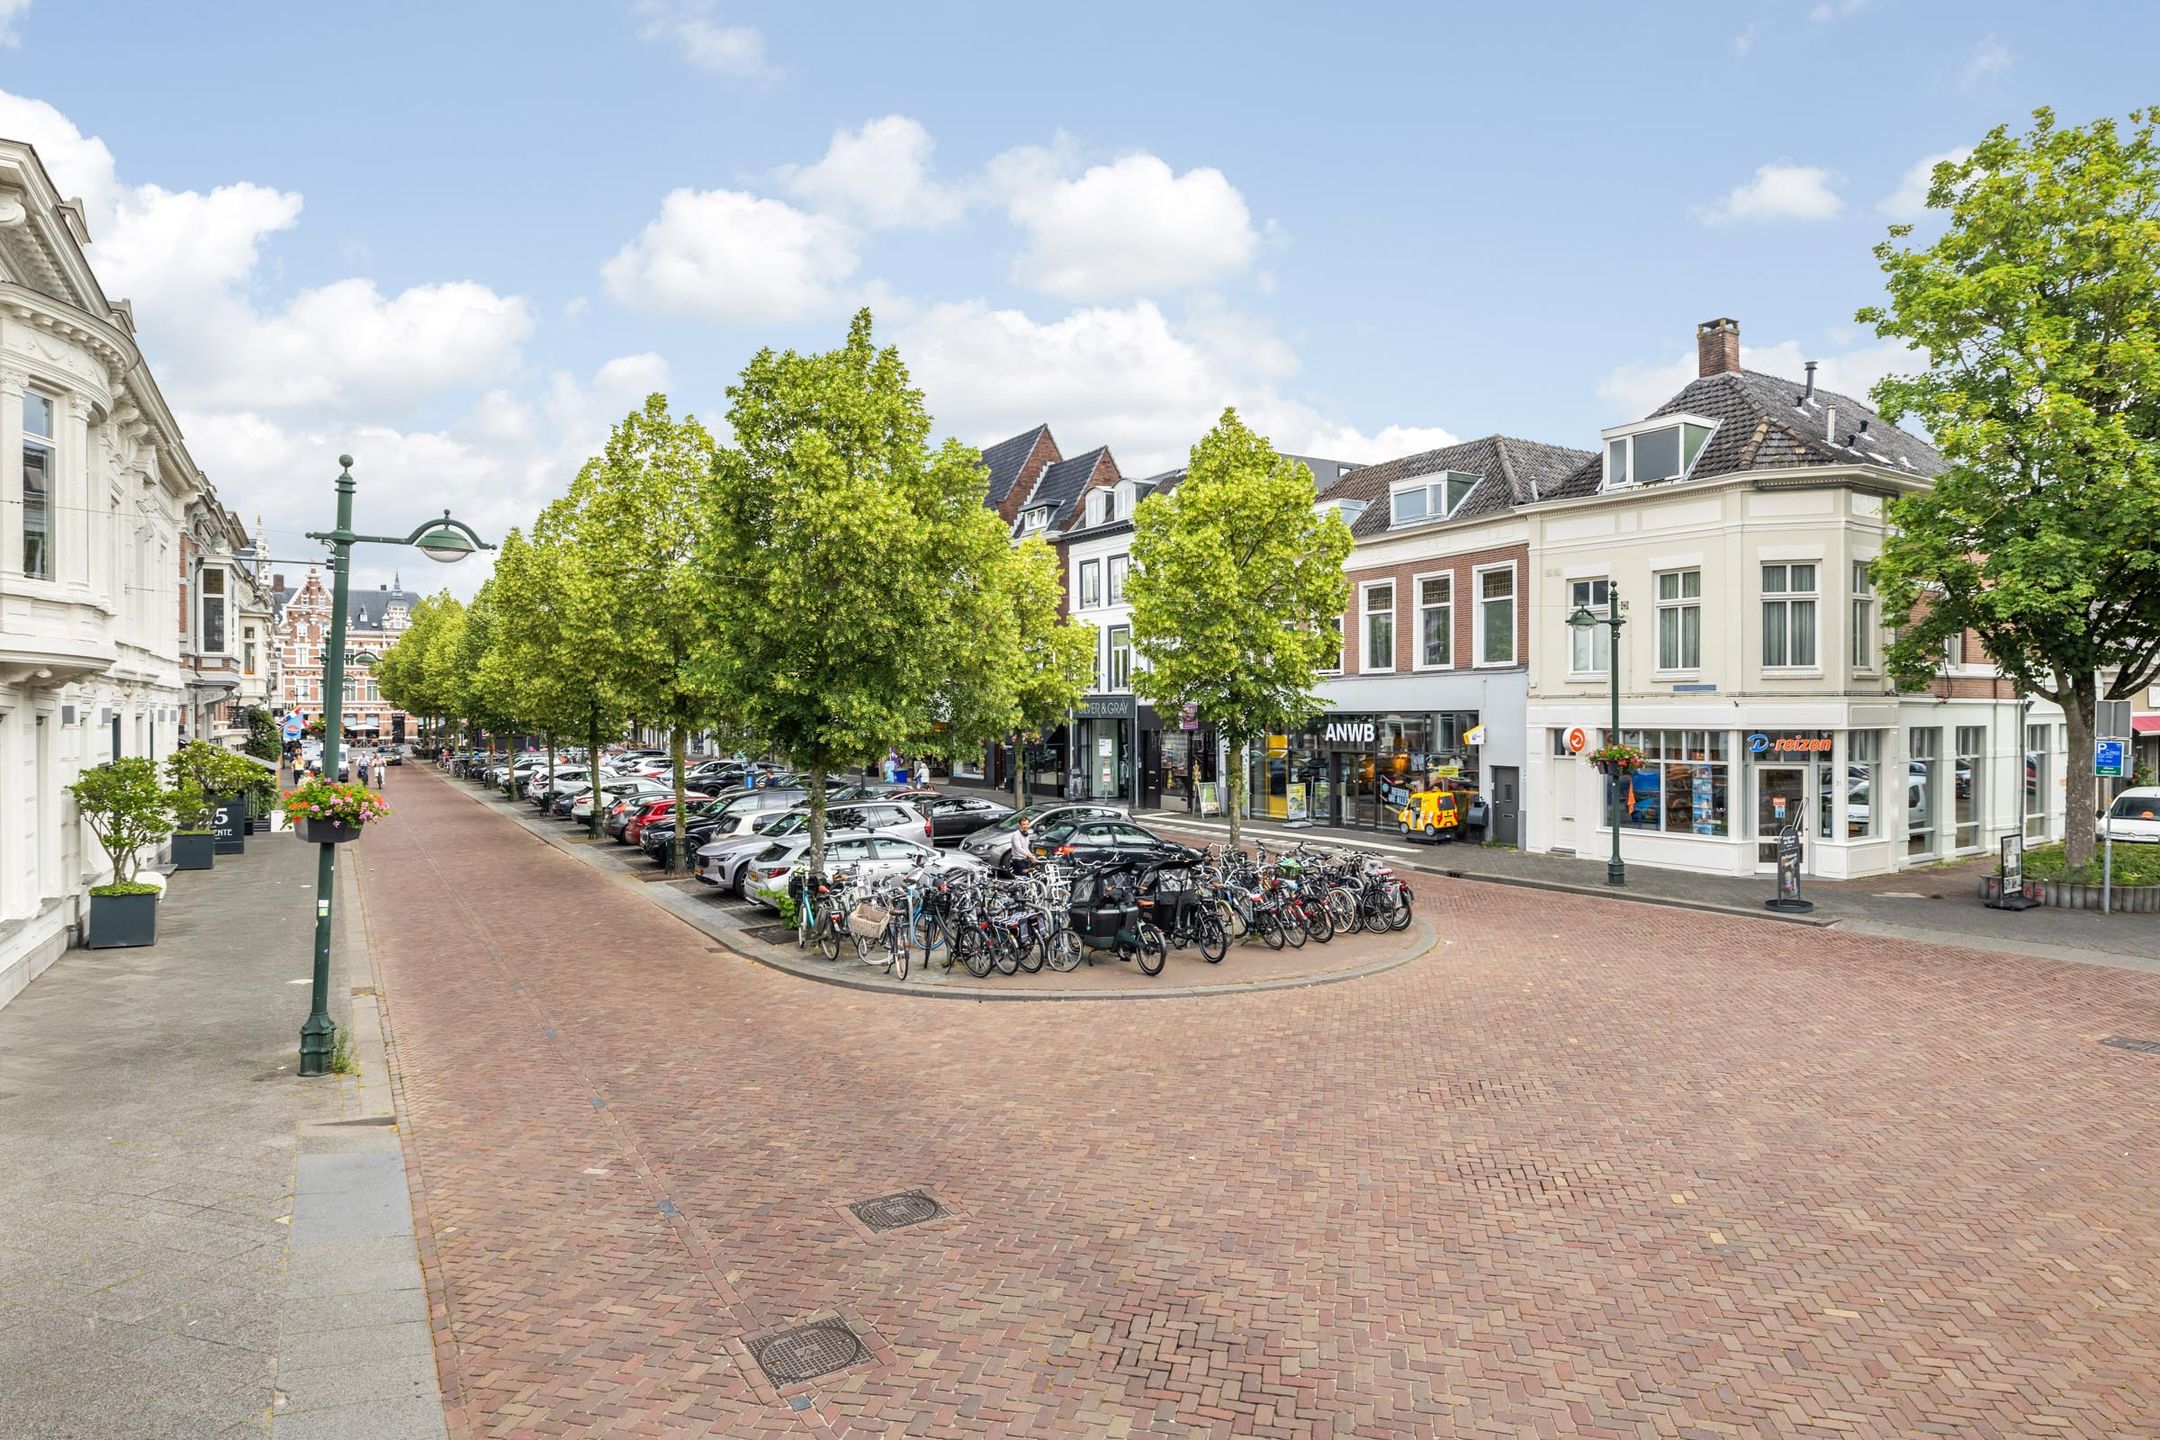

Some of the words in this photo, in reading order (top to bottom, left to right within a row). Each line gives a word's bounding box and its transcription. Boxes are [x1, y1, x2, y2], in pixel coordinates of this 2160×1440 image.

[1107, 698, 1129, 715] GRAY
[1324, 723, 1375, 742] ANWB
[1747, 733, 1832, 753] D-reizen
[2097, 743, 2108, 754] P
